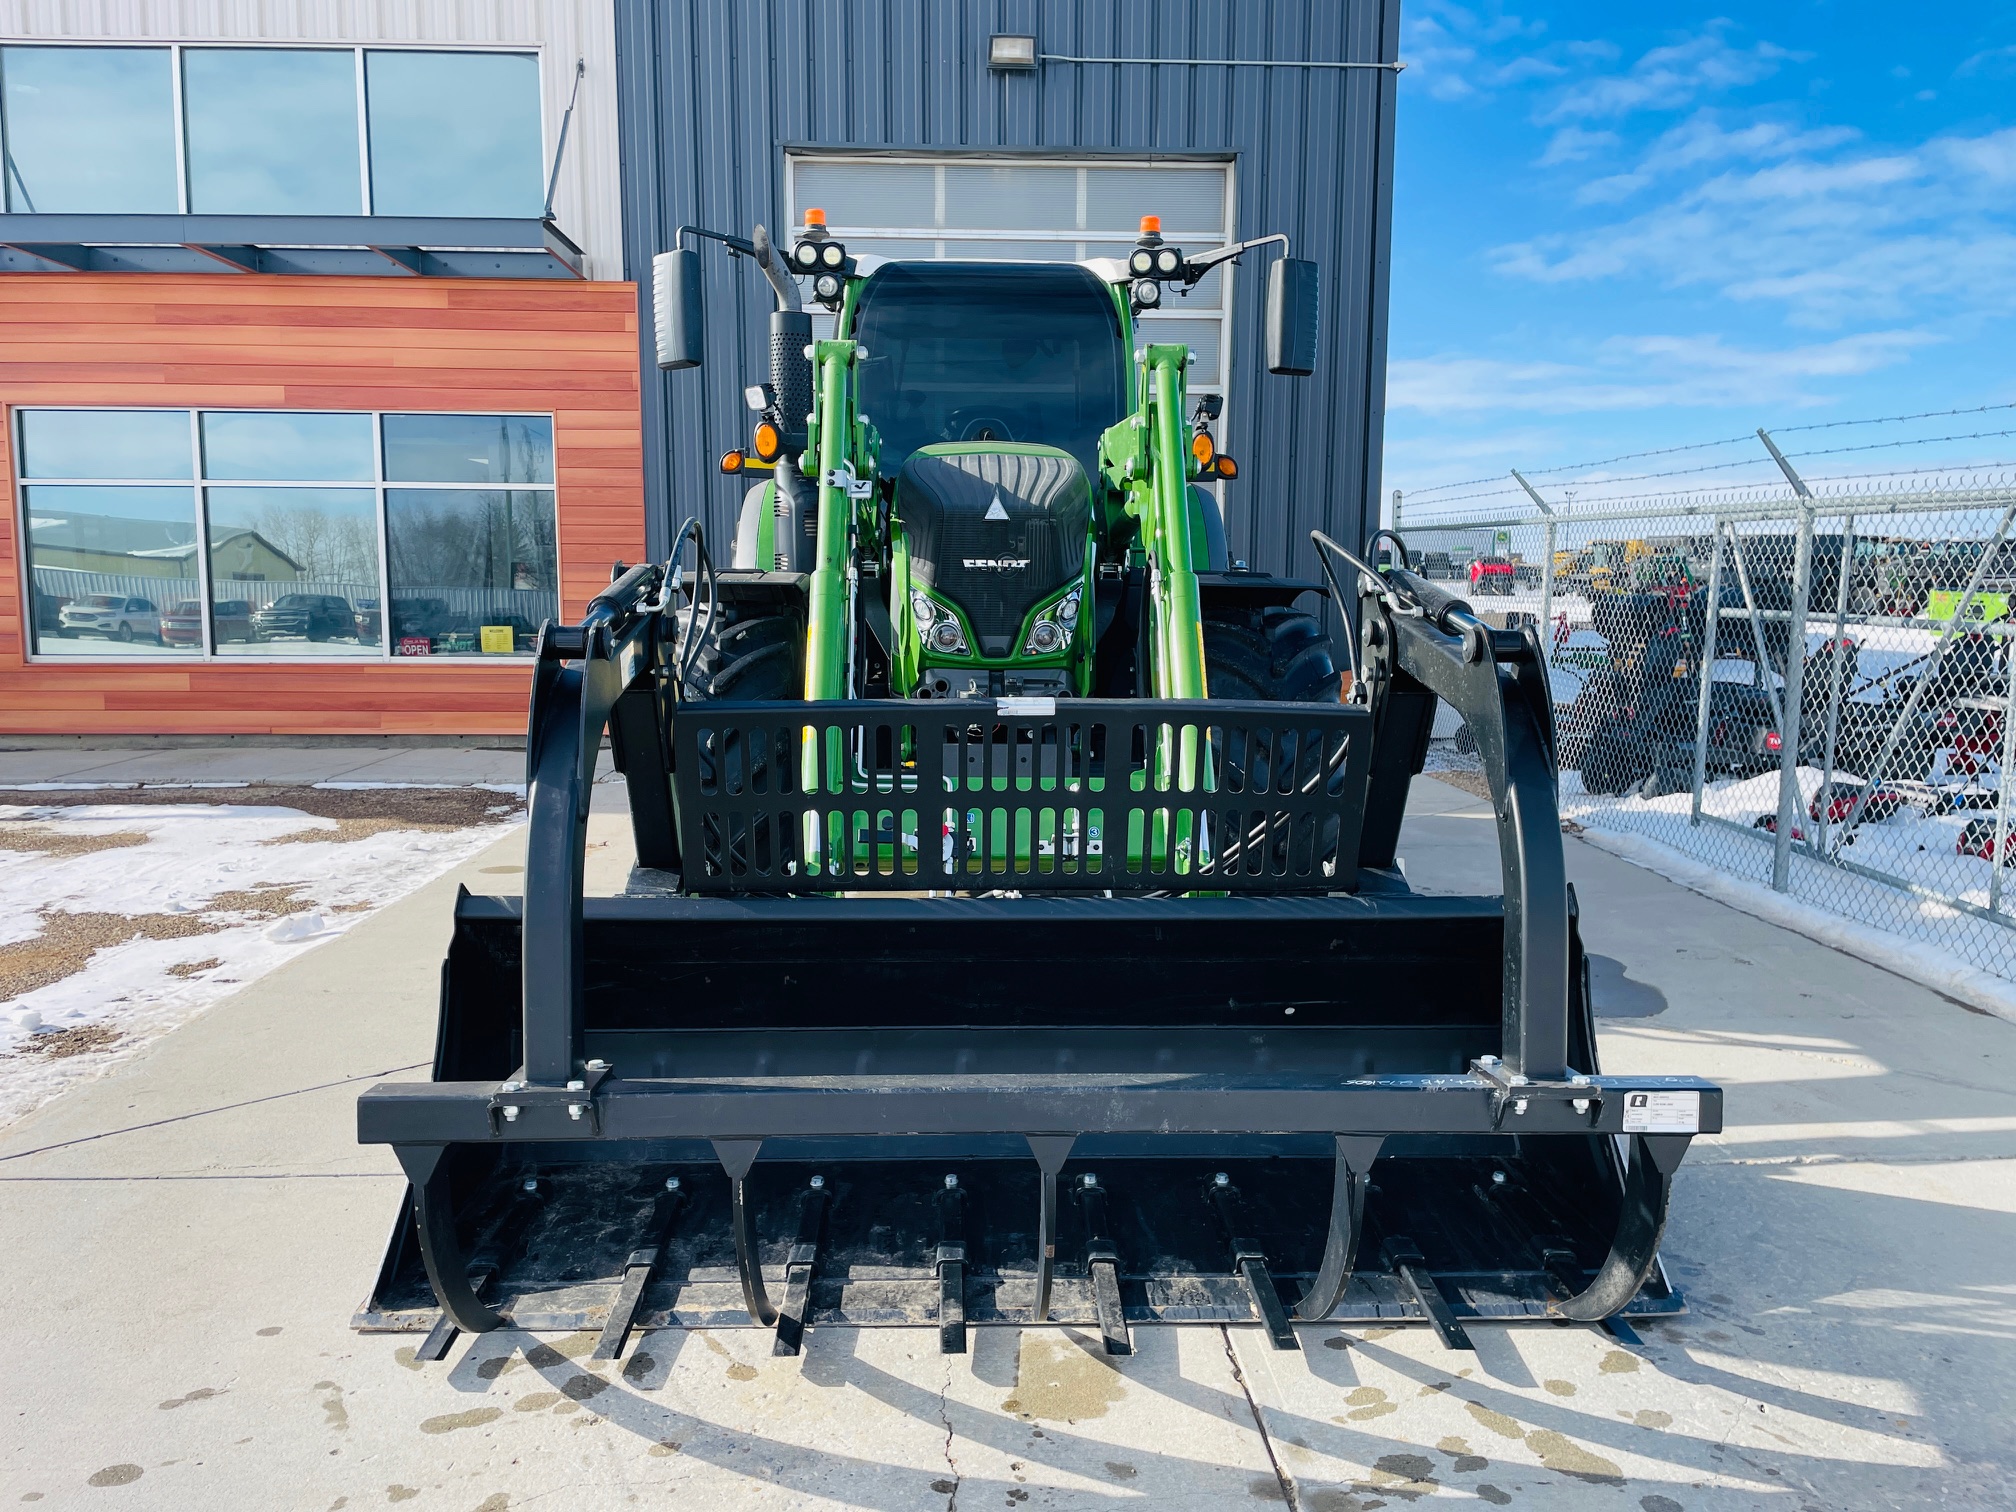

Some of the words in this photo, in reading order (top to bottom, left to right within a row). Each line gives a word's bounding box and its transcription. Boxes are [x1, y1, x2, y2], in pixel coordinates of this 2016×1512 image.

[962, 558, 1031, 571] FENDT
[404, 644, 429, 656] OPEN
[1091, 828, 1098, 836] 3
